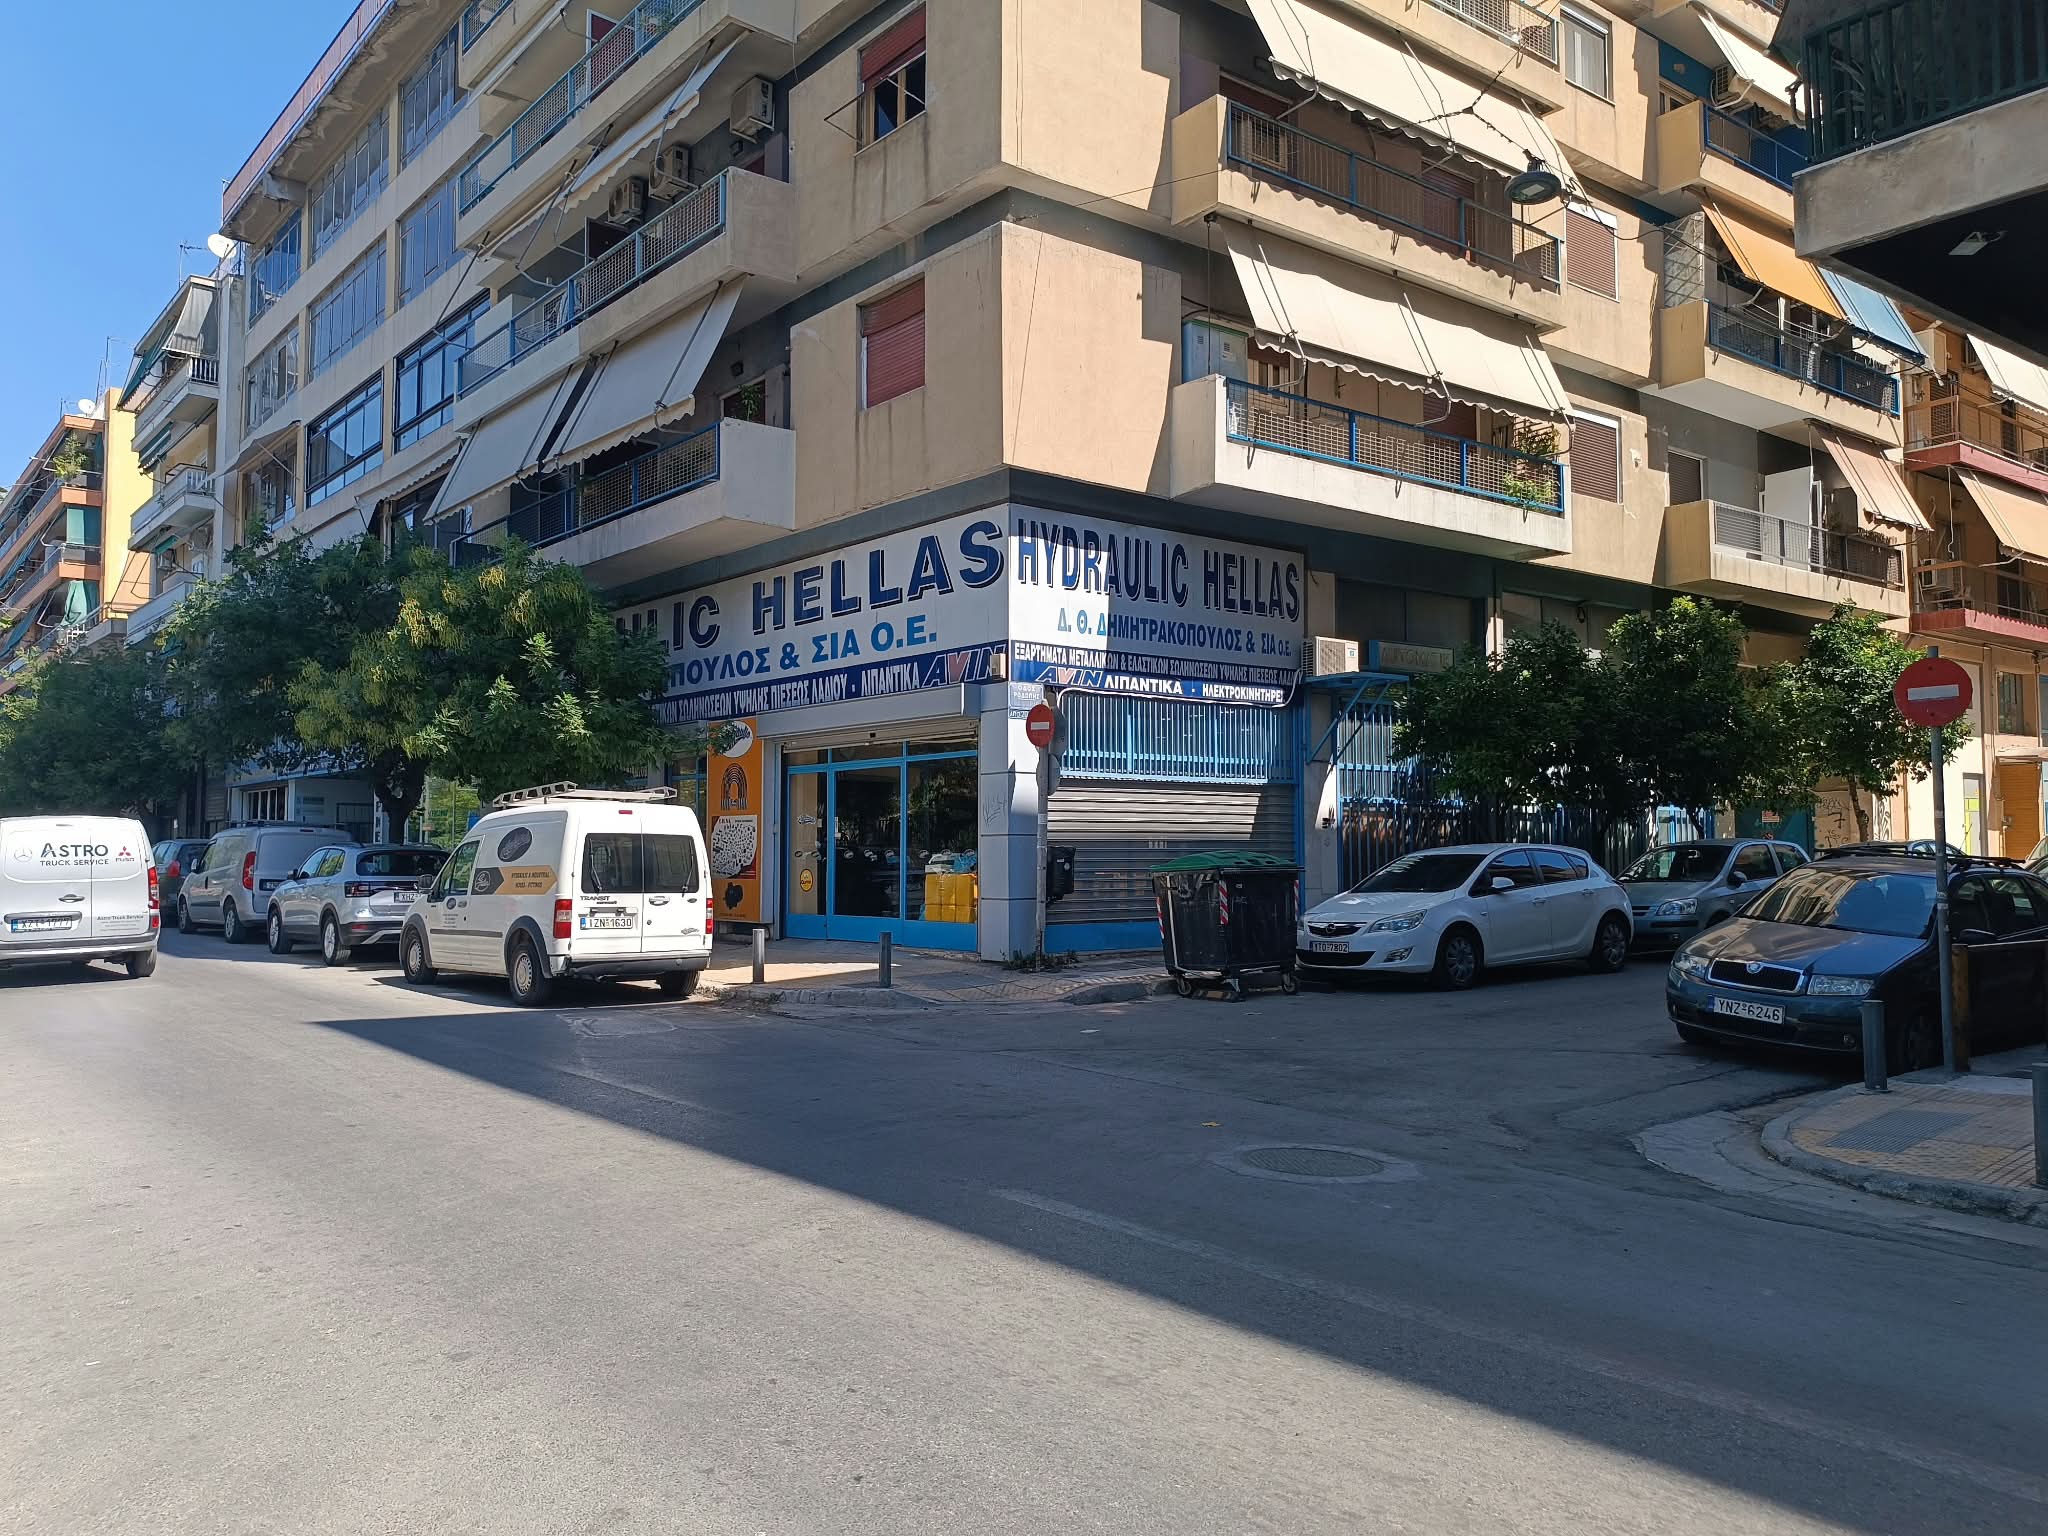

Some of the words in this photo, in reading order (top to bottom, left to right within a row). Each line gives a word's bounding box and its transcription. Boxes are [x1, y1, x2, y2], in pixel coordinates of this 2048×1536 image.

[752, 520, 1004, 636] HELLAS
[1018, 518, 1188, 608] HYDRAULIC
[1203, 549, 1300, 623] HELLAS
[667, 645, 771, 690] ΠΟΥΛΟΣ
[779, 642, 799, 670] &
[811, 629, 861, 663] ΣΙΑ
[870, 614, 937, 652] Ο.Ε.
[1057, 607, 1072, 633] Δ.
[1076, 609, 1092, 635] Θ.
[1096, 612, 1242, 652] ΔΗΜΗΤΡΑΚΟΠΟΥΛΟΣ
[1245, 630, 1256, 653] &
[1261, 632, 1276, 656] ΣΙΑ
[1014, 642, 1067, 666] ΕΞΑΡΤΗΜΑΤΑ
[1068, 648, 1119, 671] ΜΕΤΑΛΛΙΚΩΝ
[1120, 654, 1126, 671] &
[1127, 655, 1168, 675] ΕΛΑΣΤΙΚΩΝ
[1170, 658, 1219, 680] ΣΩΛΗΝΩΣΕΩΝ
[1220, 664, 1248, 682] ΥΨΗΛΗΣ
[1035, 665, 1104, 688] AVIN
[1104, 674, 1183, 695] ΛΙΠΑΝΤΙΚΑ
[733, 685, 770, 713] ΥΨΗΛΗΣ
[770, 679, 810, 709] ΠΙΕΣΕΩΣ
[811, 673, 848, 704] ΛΑΔΙΟΥ
[861, 661, 920, 697] ΛΙΠΑΝΤΙΚΑ
[41, 842, 109, 858] ASTRO
[41, 859, 71, 867] TRUCK
[73, 858, 110, 866] SERVICE
[1718, 998, 1781, 1022] YNZ-6246
